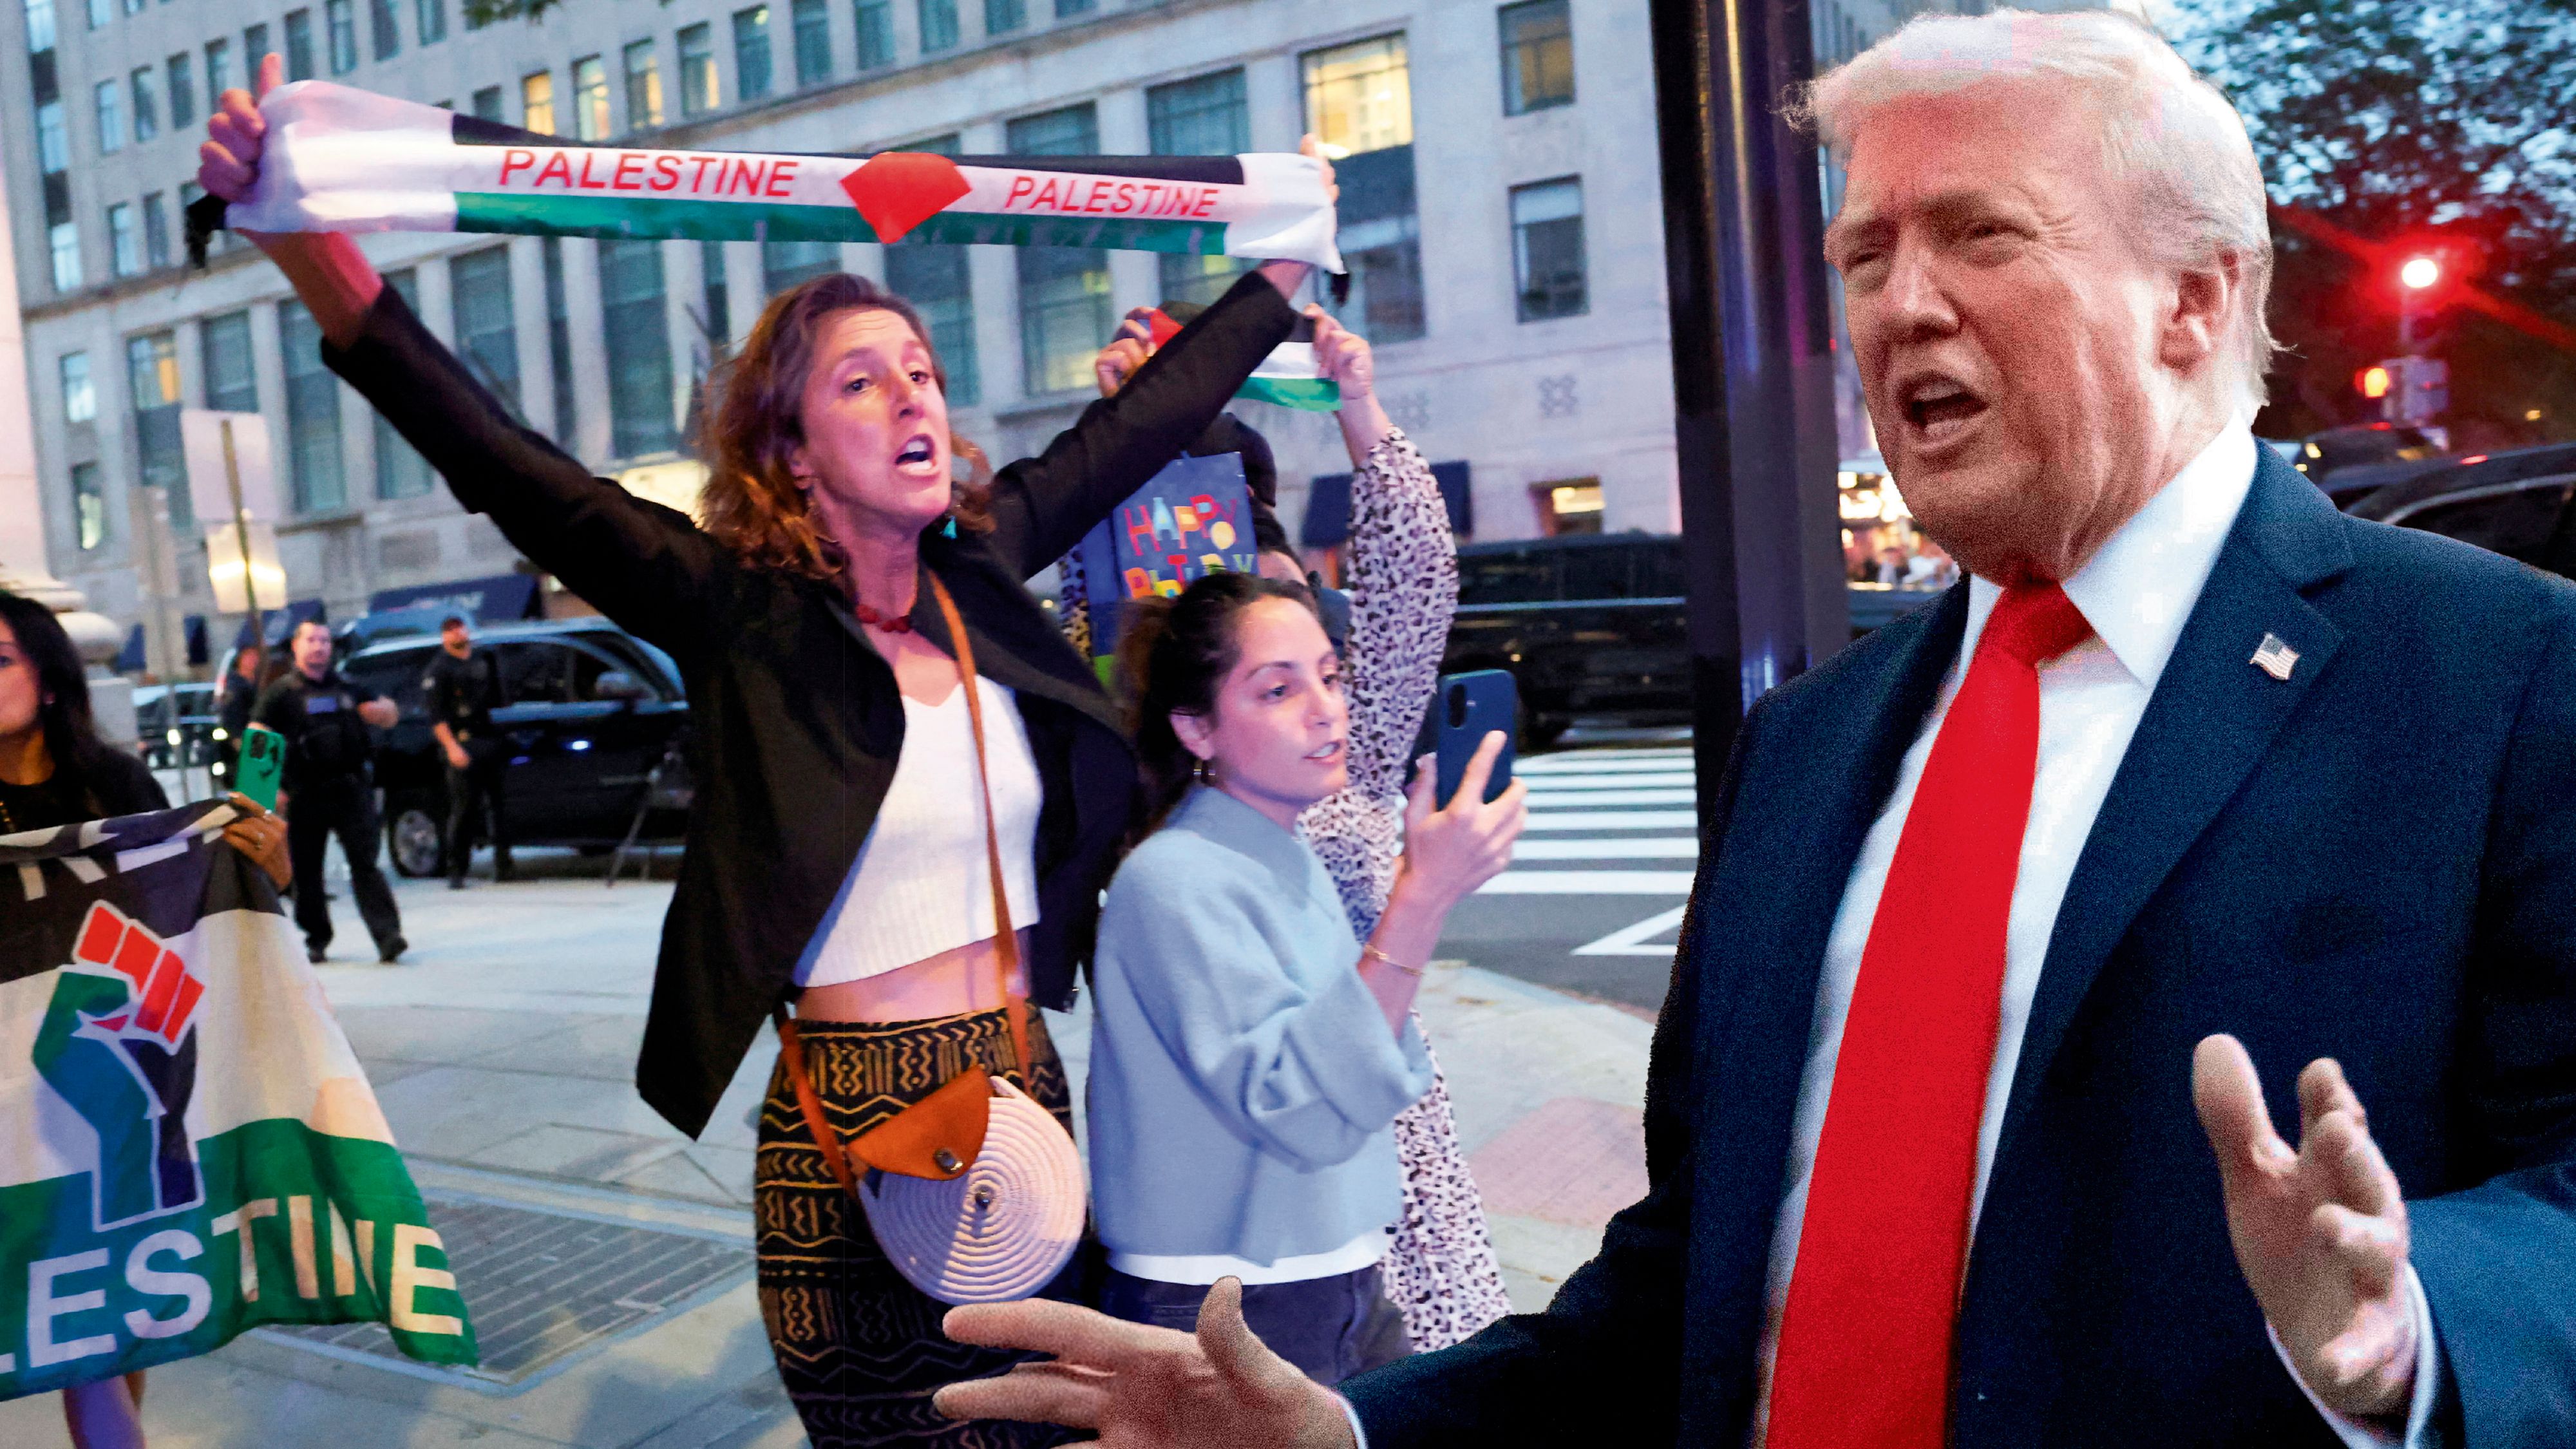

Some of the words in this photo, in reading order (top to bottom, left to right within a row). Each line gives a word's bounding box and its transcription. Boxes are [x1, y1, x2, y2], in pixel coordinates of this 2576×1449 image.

[498, 149, 799, 196] PALESTINE
[1004, 175, 1219, 217] PALESTINE
[1124, 493, 1238, 556] HAPPY
